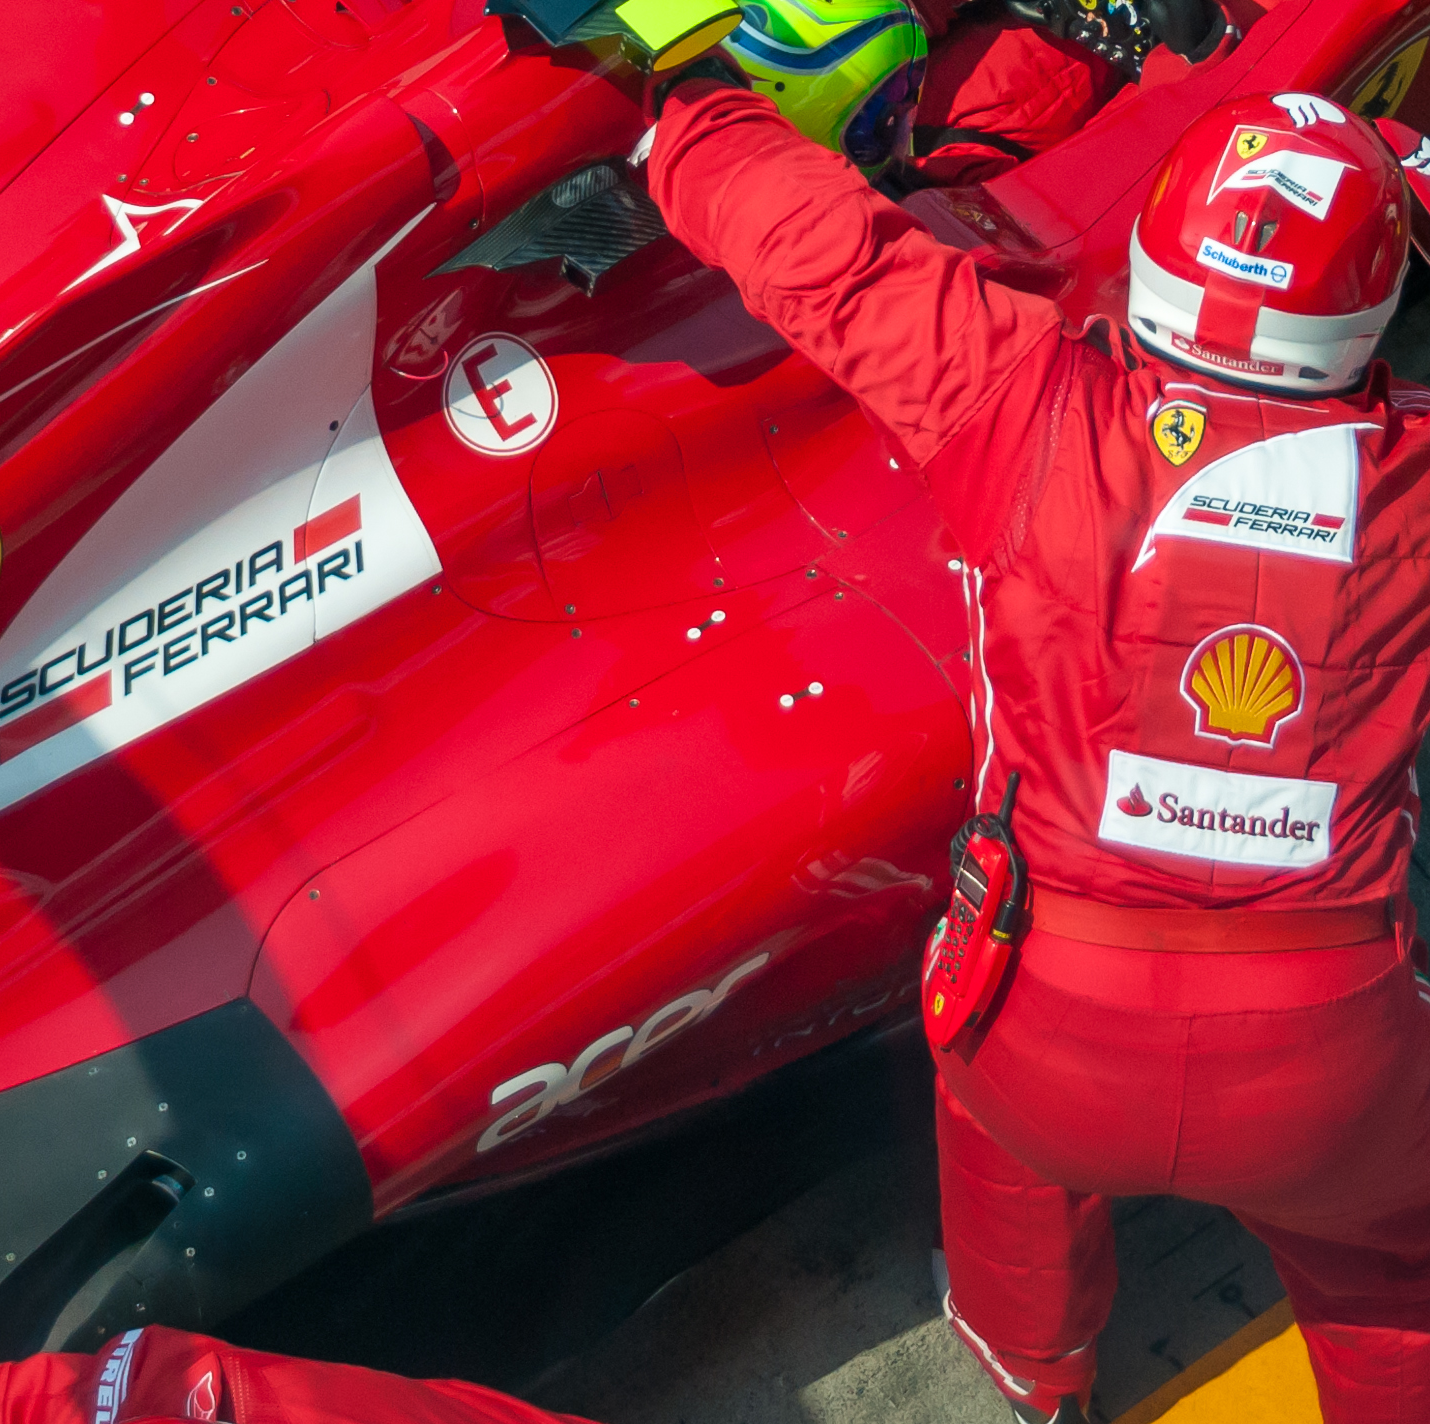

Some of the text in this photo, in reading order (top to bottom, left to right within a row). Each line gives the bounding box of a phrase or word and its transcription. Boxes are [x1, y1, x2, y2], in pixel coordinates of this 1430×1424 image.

[1202, 244, 1269, 278] Schuberth
[1191, 342, 1279, 374] Santander
[462, 341, 537, 443] E
[1190, 495, 1312, 524] SCUDERIA
[1233, 515, 1339, 544] FERRARI
[122, 539, 367, 699] FERRARI
[1157, 791, 1321, 843] Santander
